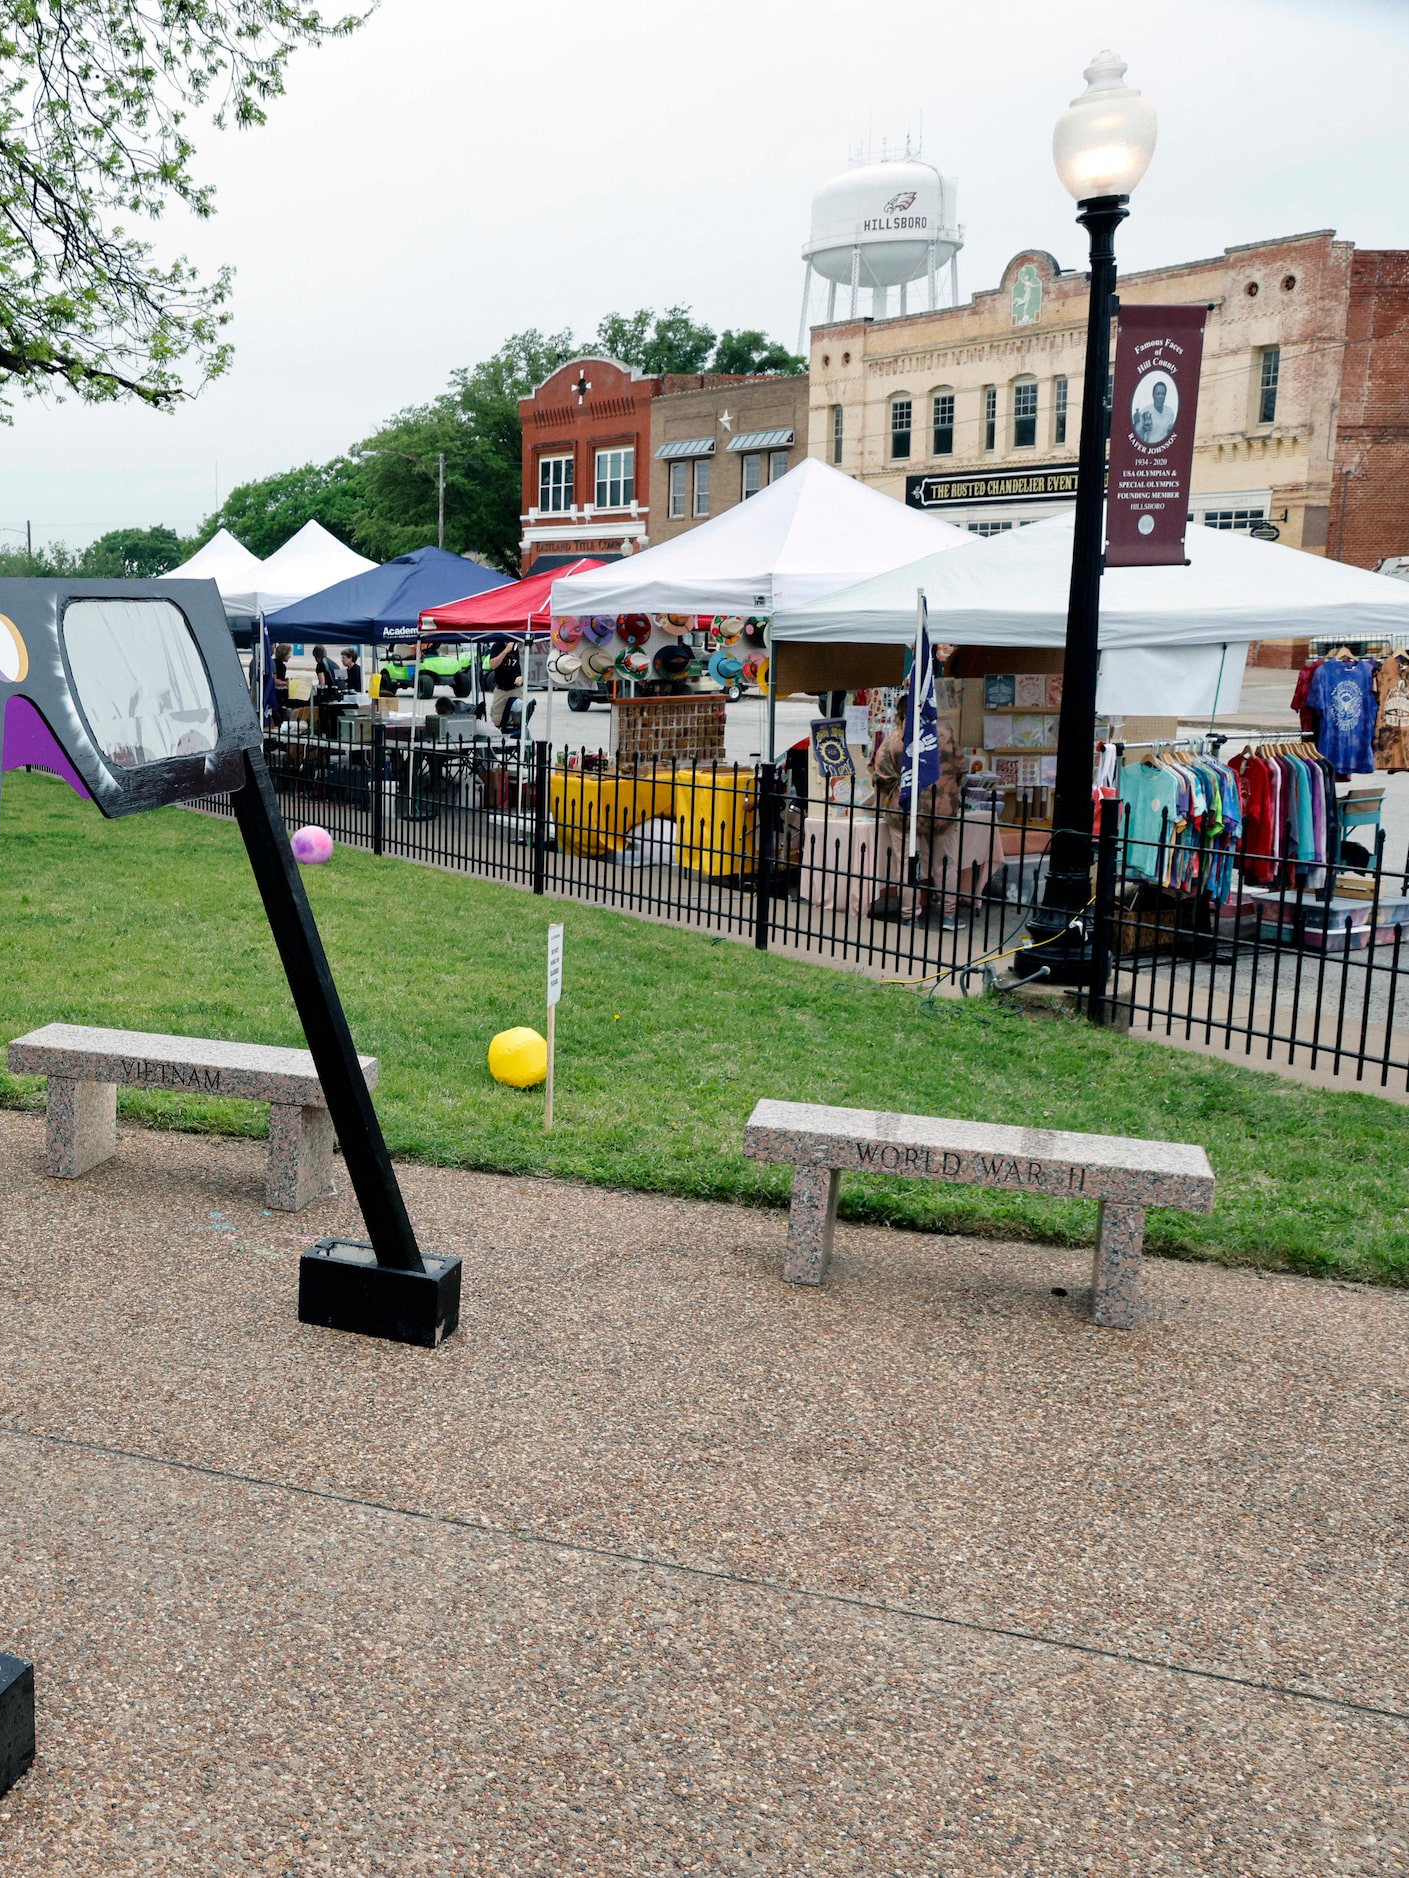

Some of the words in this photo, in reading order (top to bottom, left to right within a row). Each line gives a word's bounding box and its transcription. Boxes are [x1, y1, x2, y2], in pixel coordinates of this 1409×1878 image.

[863, 216, 928, 232] HILLSBORO
[1133, 338, 1164, 355] Famous
[1164, 337, 1184, 356] Faces
[1154, 347, 1163, 357] of
[1136, 359, 1152, 375] Hill
[1152, 357, 1179, 375] County
[1126, 431, 1148, 455] RAFER
[1147, 431, 1178, 456] JOHNSON
[1135, 458, 1149, 467] 1934
[1153, 458, 1168, 467] 2020
[1122, 469, 1136, 478] USA
[1136, 469, 1171, 478] OLYMPIAN
[1171, 469, 1178, 477] &
[931, 484, 951, 499] THE
[951, 482, 986, 498] RUSTED
[987, 476, 1046, 496] CHANDELIER
[1118, 480, 1146, 489] SPECIAL
[1146, 480, 1180, 489] OLYMPICS
[1117, 491, 1151, 500] FOUNDING
[1151, 491, 1180, 500] MEMBER
[1130, 503, 1165, 511] HILLSBORO
[536, 543, 571, 552] EASTLAND
[575, 541, 594, 552] TITLE
[120, 1059, 221, 1090] VIETNAM
[856, 1141, 963, 1177] WORLD
[981, 1155, 1045, 1188] WAR
[1068, 1166, 1086, 1194] II
